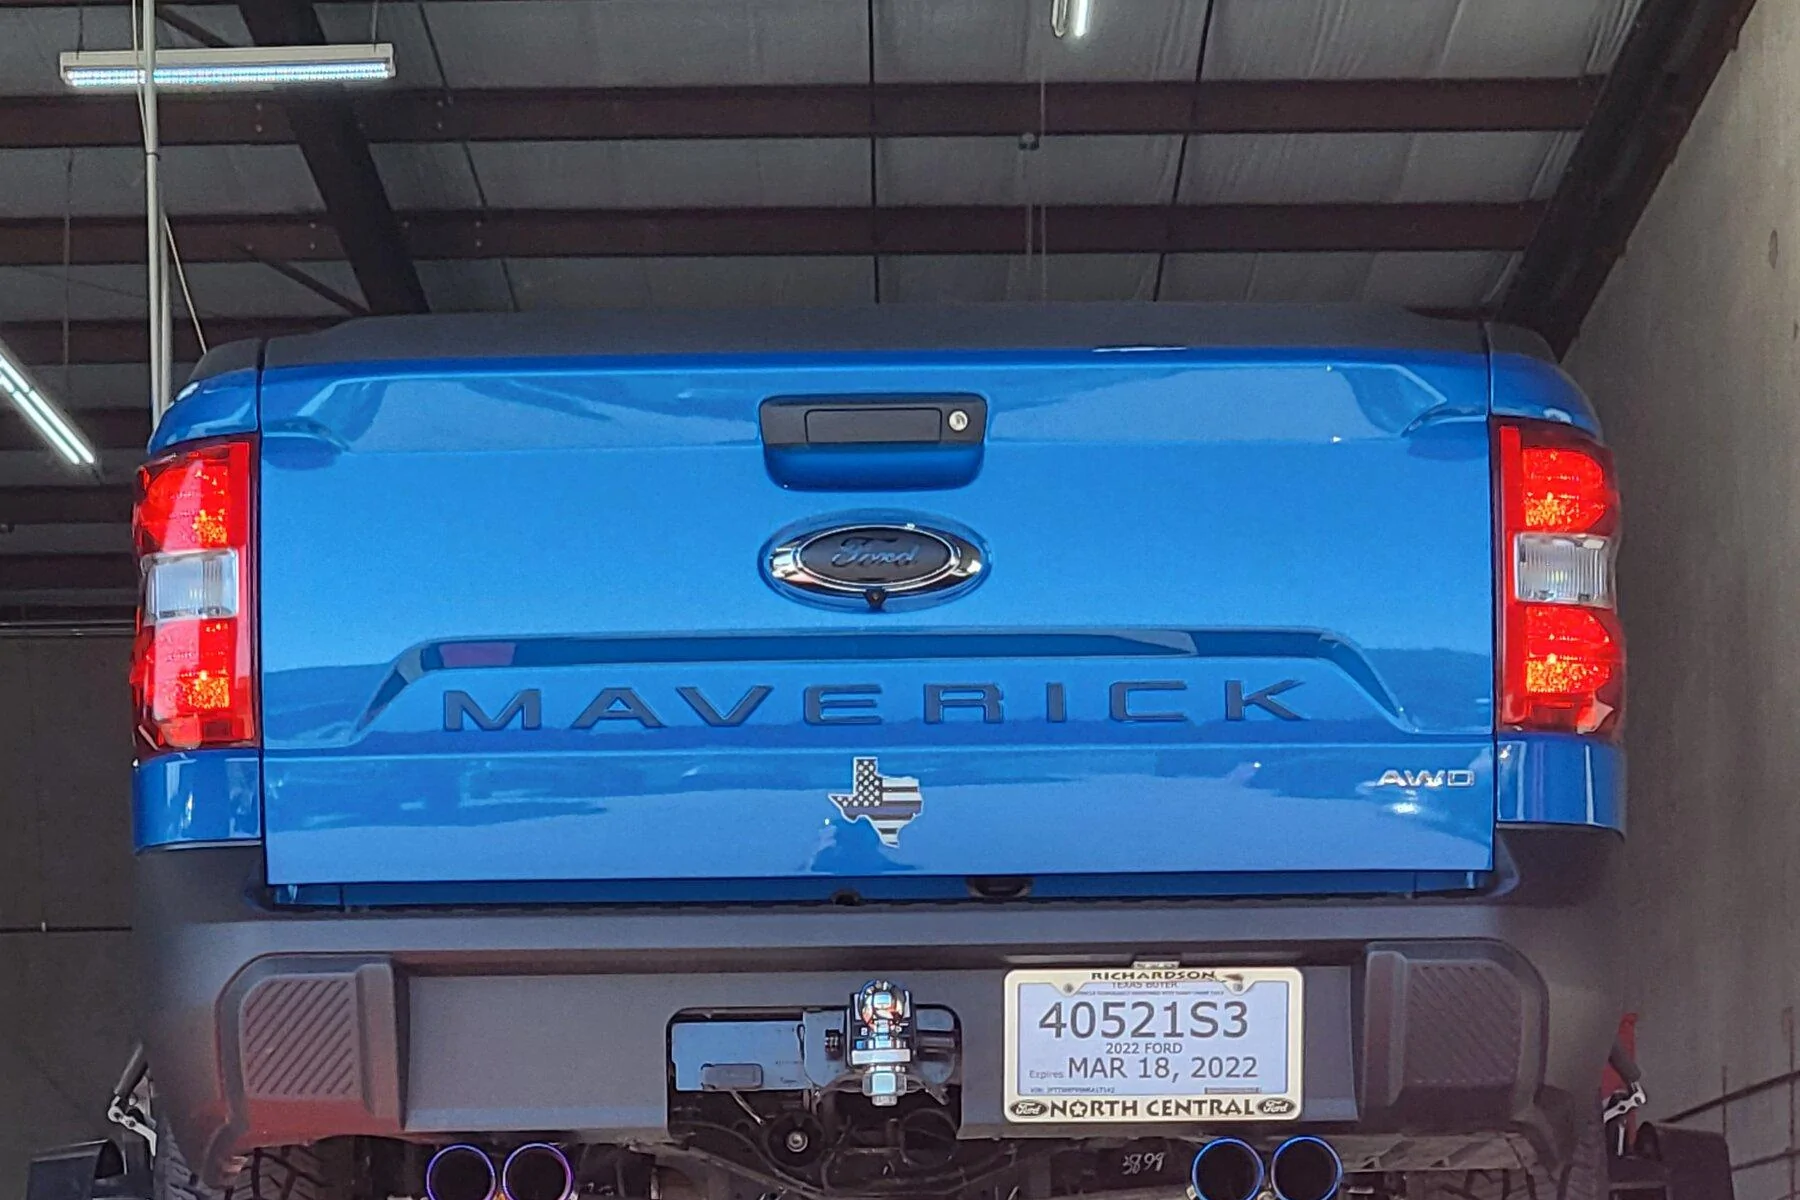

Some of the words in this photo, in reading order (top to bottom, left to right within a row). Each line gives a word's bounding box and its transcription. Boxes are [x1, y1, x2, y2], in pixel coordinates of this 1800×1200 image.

[831, 536, 919, 567] Ford
[442, 676, 1306, 733] MAVERICK
[1376, 769, 1475, 787] AWD
[1091, 970, 1215, 980] RICHARDSON
[1038, 1001, 1248, 1039] 40521S3
[1105, 1042, 1140, 1055] 2022
[1144, 1042, 1183, 1055] FORD
[1029, 1070, 1064, 1079] Expires
[1067, 1057, 1128, 1078] MAR
[1138, 1057, 1179, 1083] 18,
[1190, 1057, 1259, 1078] 2022
[1050, 1099, 1138, 1118] NORTH
[1146, 1099, 1255, 1116] CENTRAL
